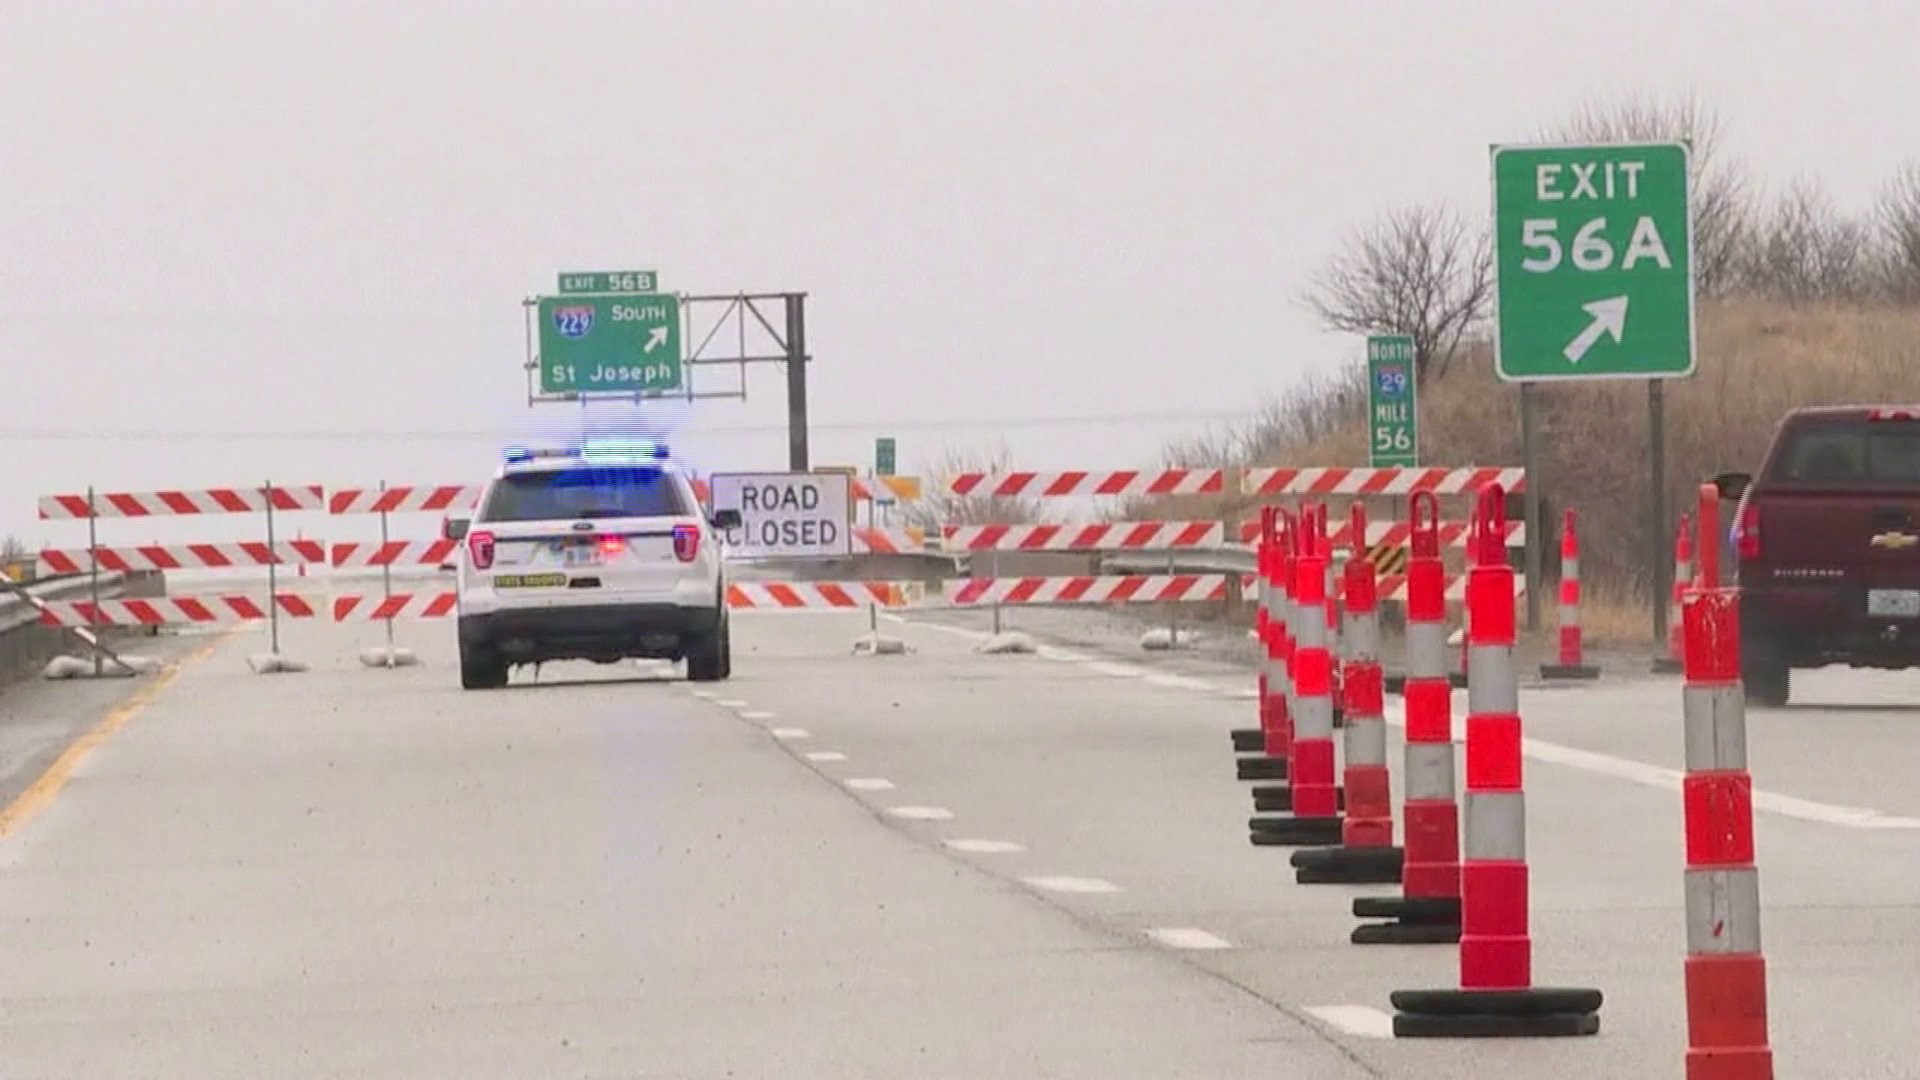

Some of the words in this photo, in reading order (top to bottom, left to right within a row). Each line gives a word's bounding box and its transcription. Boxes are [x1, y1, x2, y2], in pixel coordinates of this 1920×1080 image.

[1536, 161, 1645, 200] EXIT
[1521, 215, 1672, 272] 56A
[564, 275, 594, 290] EXIT
[608, 273, 651, 291] 56B
[561, 313, 589, 334] 229
[611, 304, 666, 321] SOUTH
[1370, 341, 1411, 361] NORTH
[552, 364, 576, 383] St
[589, 361, 672, 385] Joseph
[1381, 373, 1406, 393] 29
[1376, 404, 1408, 422] MILE
[1376, 426, 1411, 451] 56
[742, 484, 819, 511] ROAD
[724, 519, 837, 547] CLOSED
